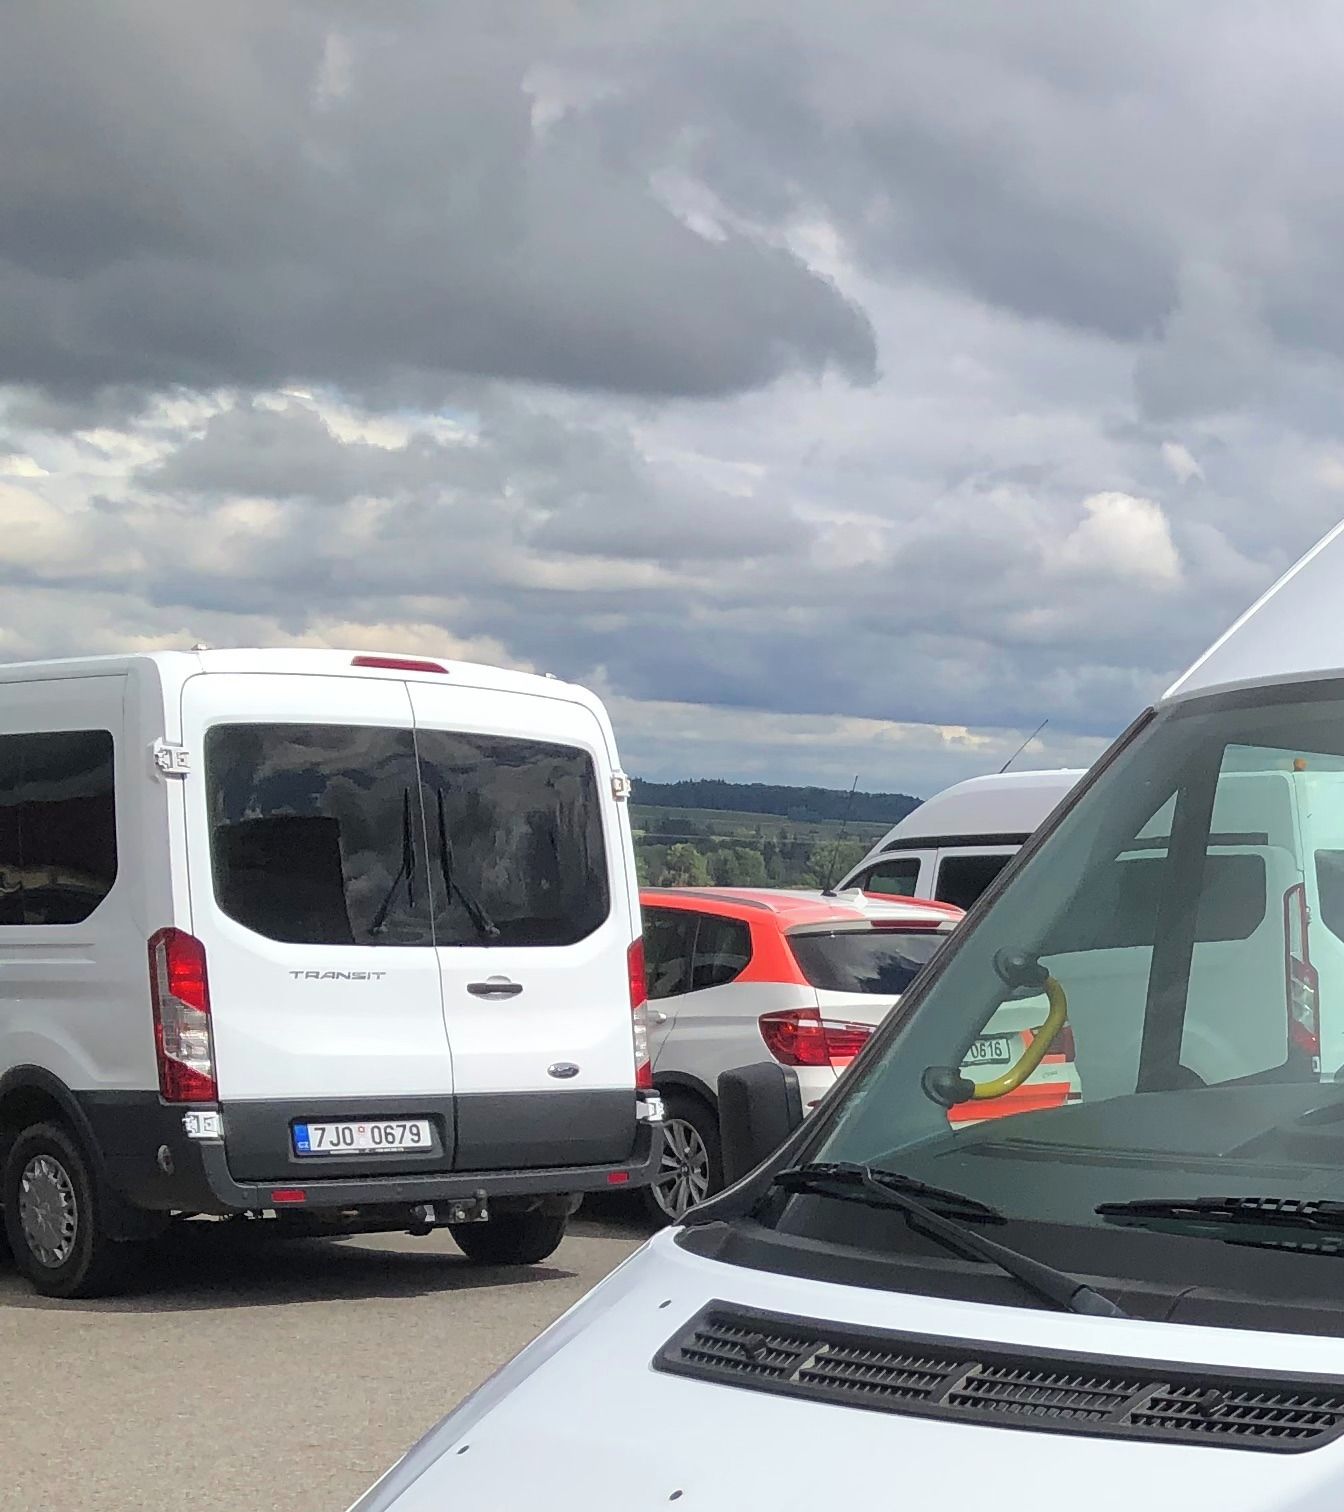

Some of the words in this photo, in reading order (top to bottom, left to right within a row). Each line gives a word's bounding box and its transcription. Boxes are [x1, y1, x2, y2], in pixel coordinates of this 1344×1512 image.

[289, 970, 386, 980] TRANSIT
[970, 1041, 1003, 1059] 0616
[314, 1126, 354, 1148] 7J0
[370, 1123, 421, 1145] 0679
